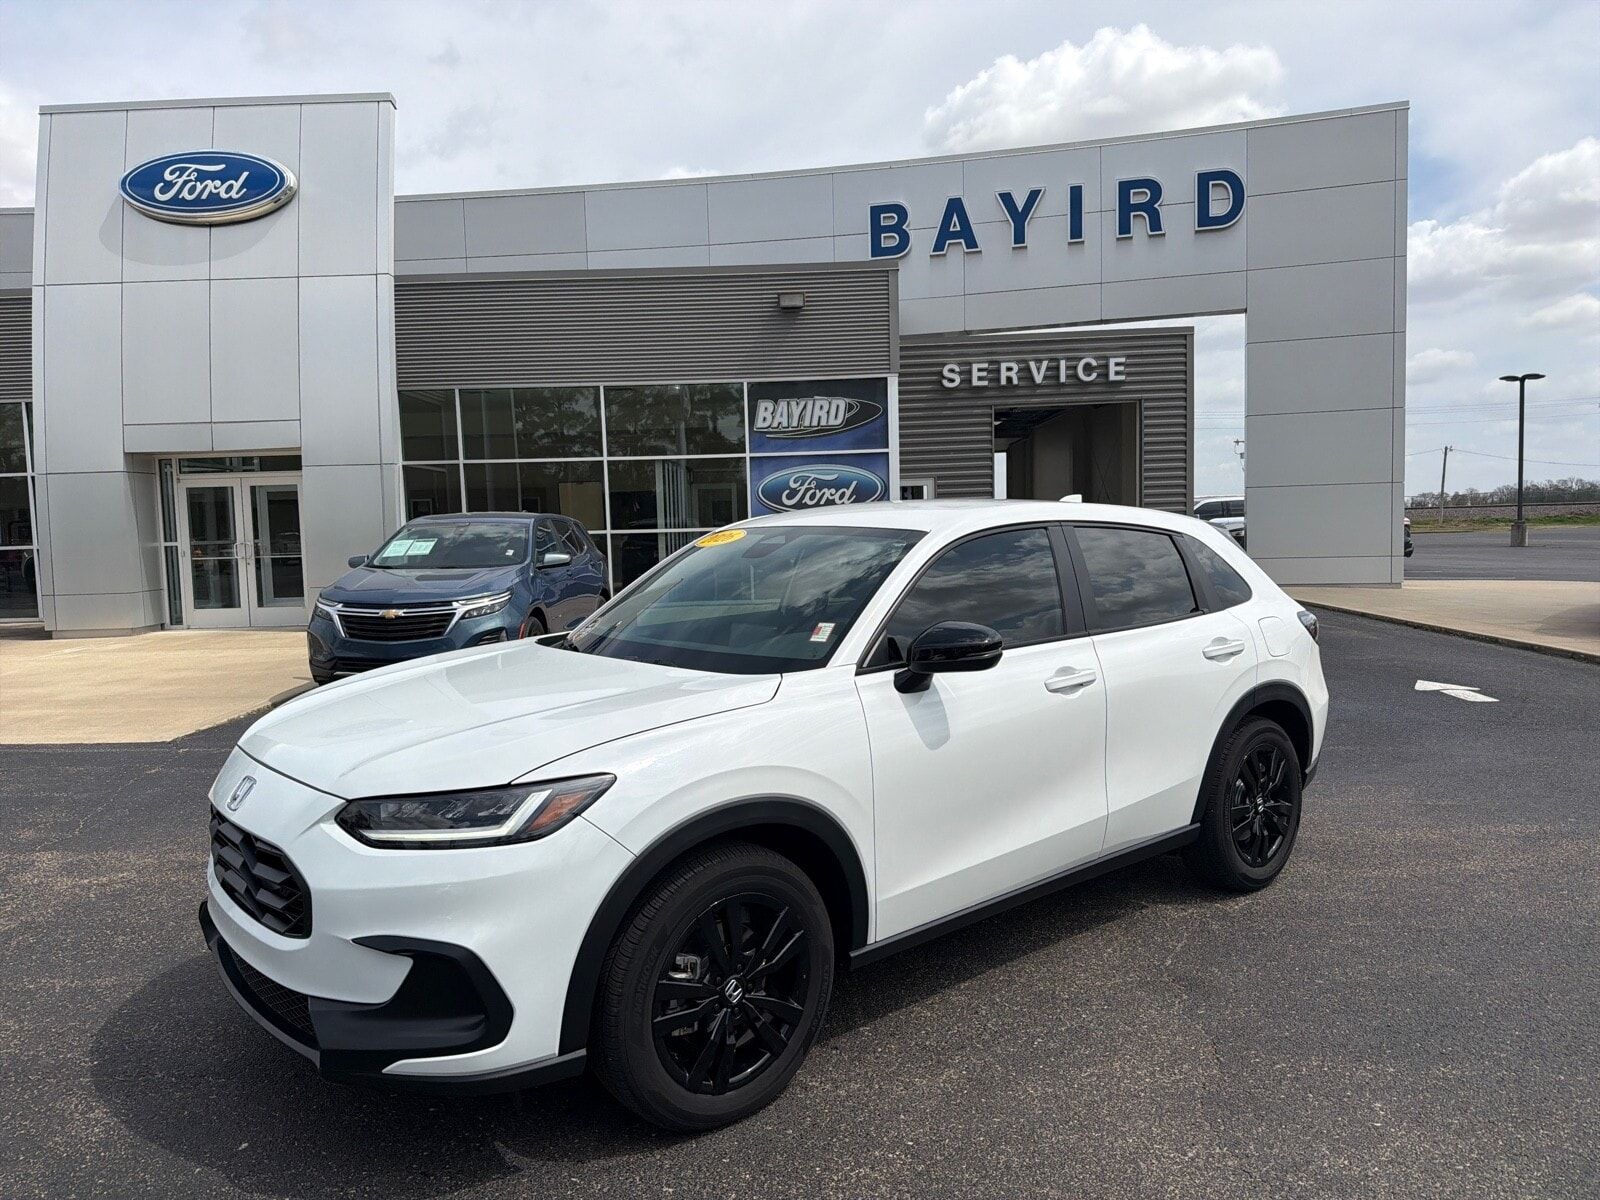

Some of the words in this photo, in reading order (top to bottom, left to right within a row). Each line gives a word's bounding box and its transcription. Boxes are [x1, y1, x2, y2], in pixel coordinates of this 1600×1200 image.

[153, 163, 250, 201] Ford
[868, 167, 1247, 260] BAYIRD
[940, 356, 1128, 389] SERVICE
[754, 396, 848, 431] BAYIRD
[781, 473, 857, 506] Ford
